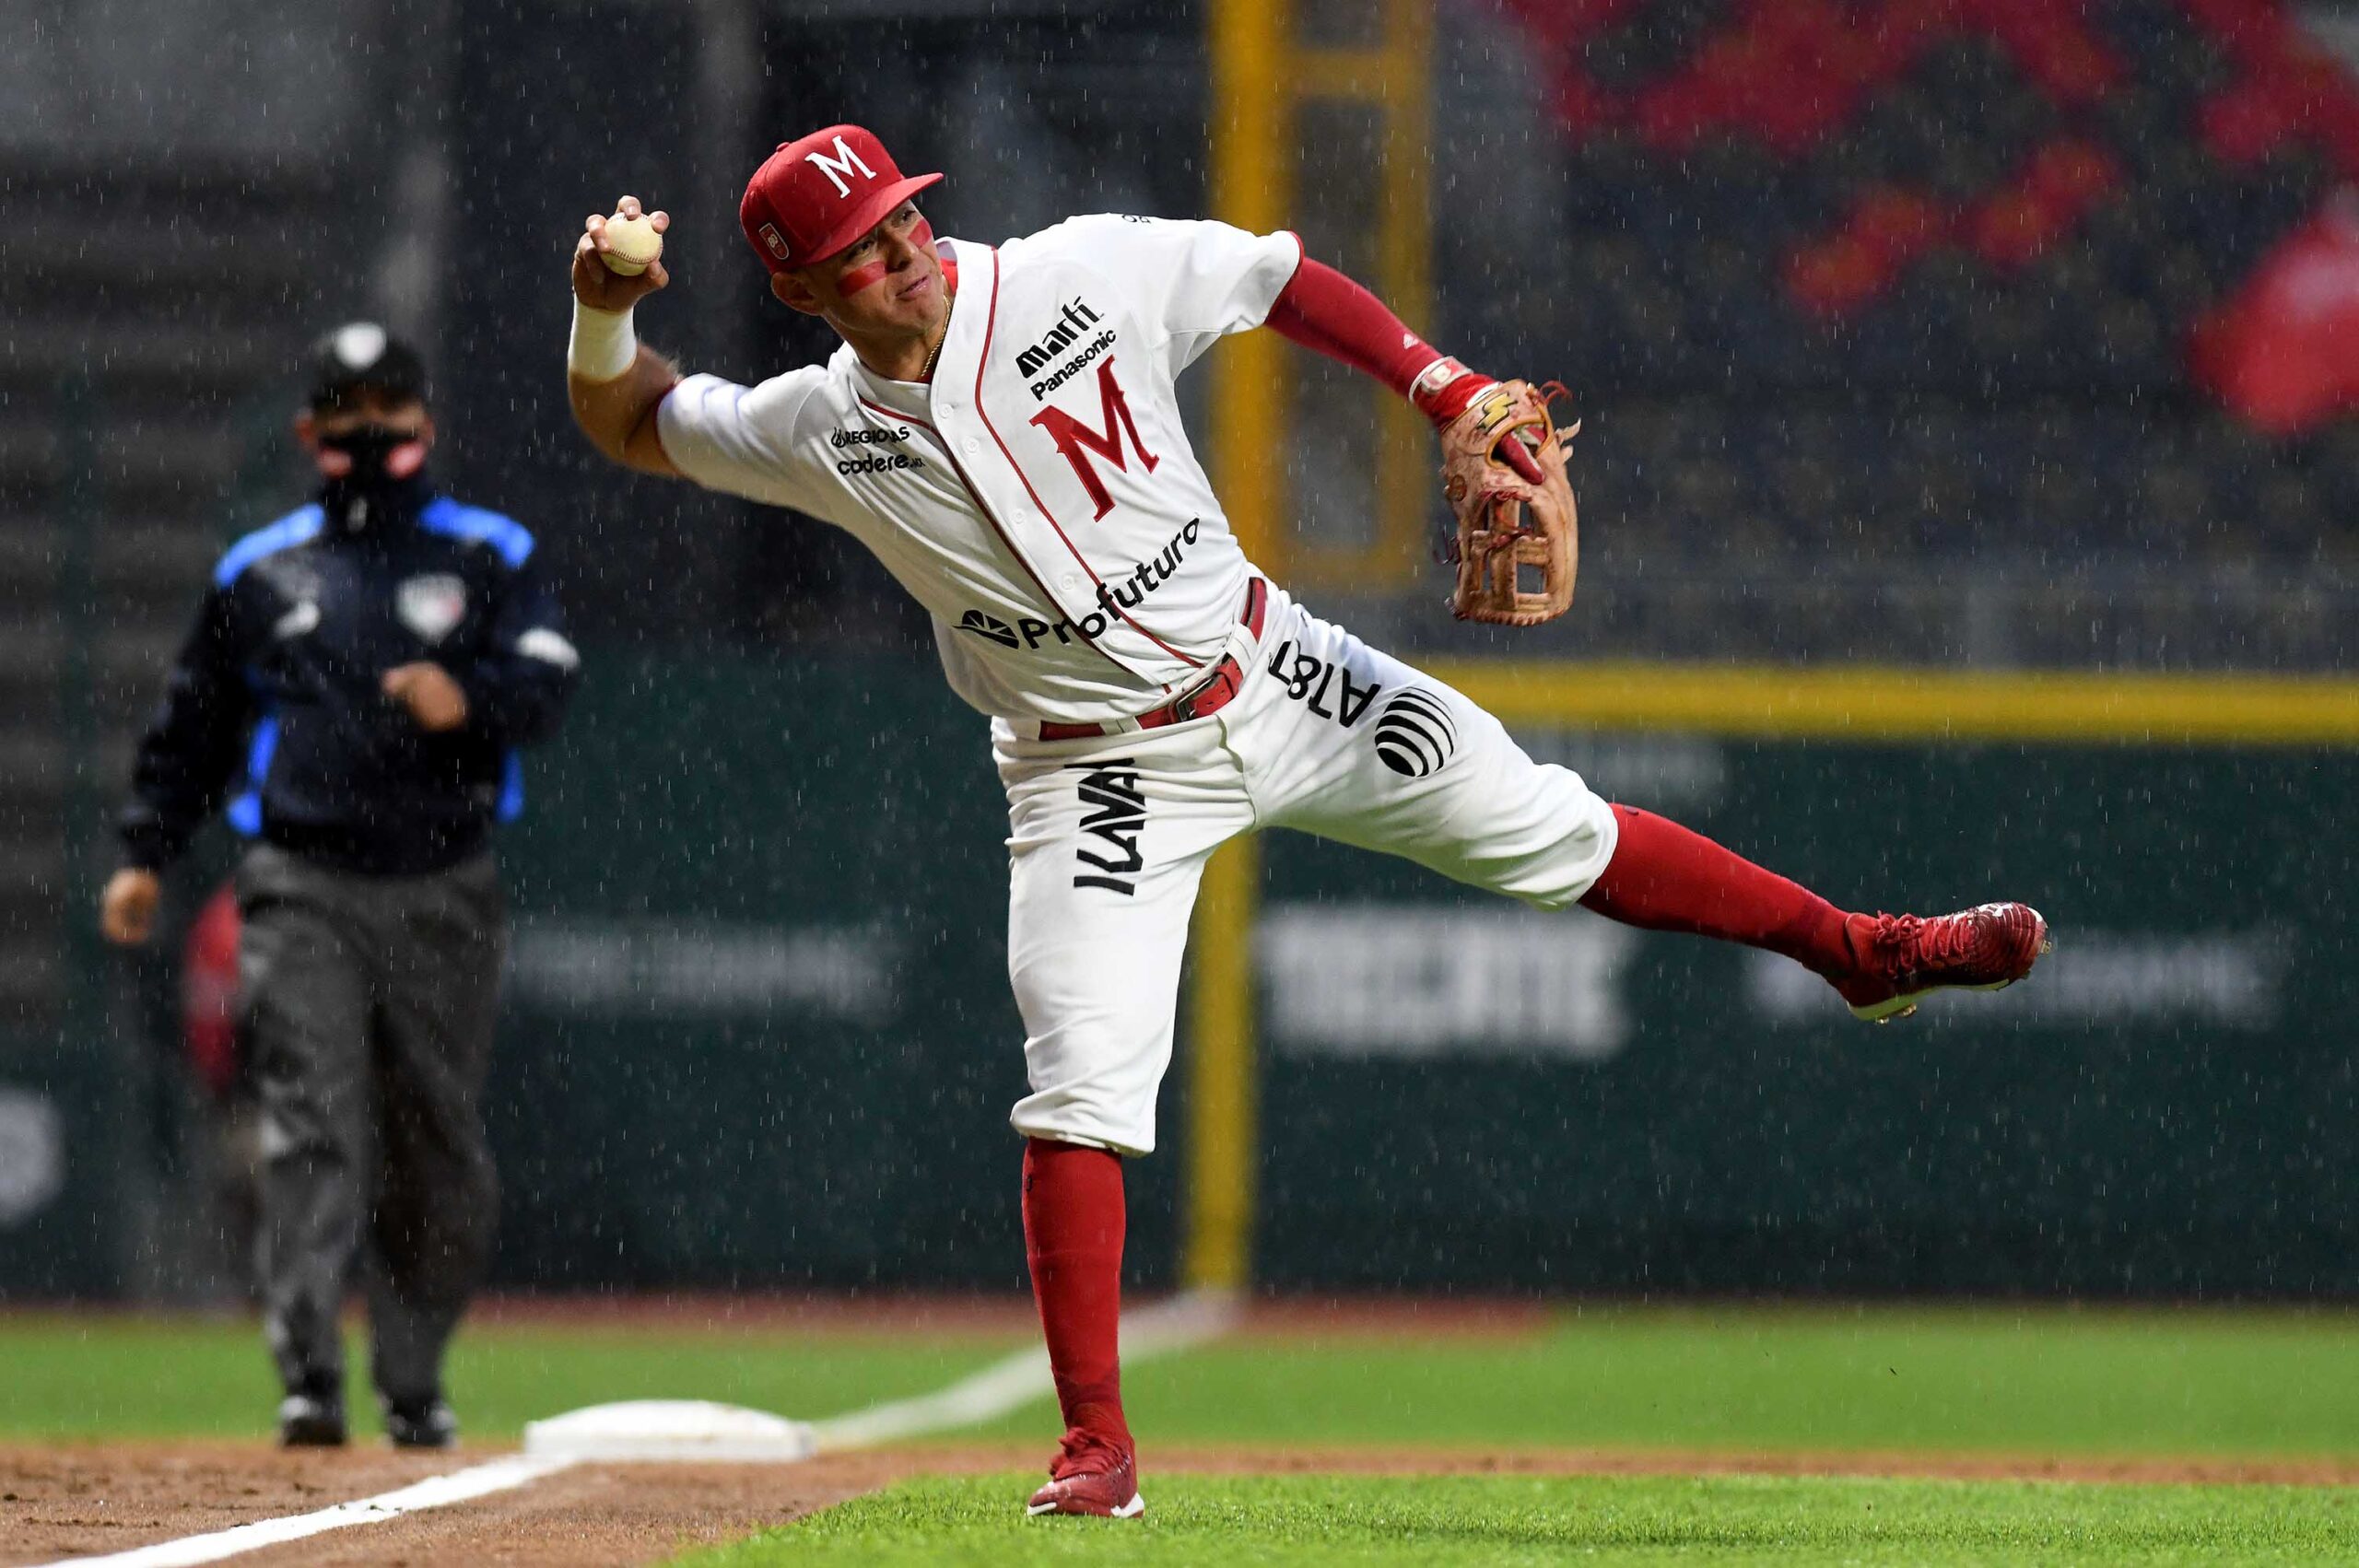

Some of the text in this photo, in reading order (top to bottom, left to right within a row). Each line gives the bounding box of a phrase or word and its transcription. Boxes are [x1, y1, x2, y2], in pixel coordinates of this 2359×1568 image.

[804, 135, 876, 199] M
[1030, 330, 1116, 402] Panasonic
[1029, 354, 1159, 522] M
[1017, 517, 1200, 649] Profuturo
[1268, 638, 1381, 728] AT&T
